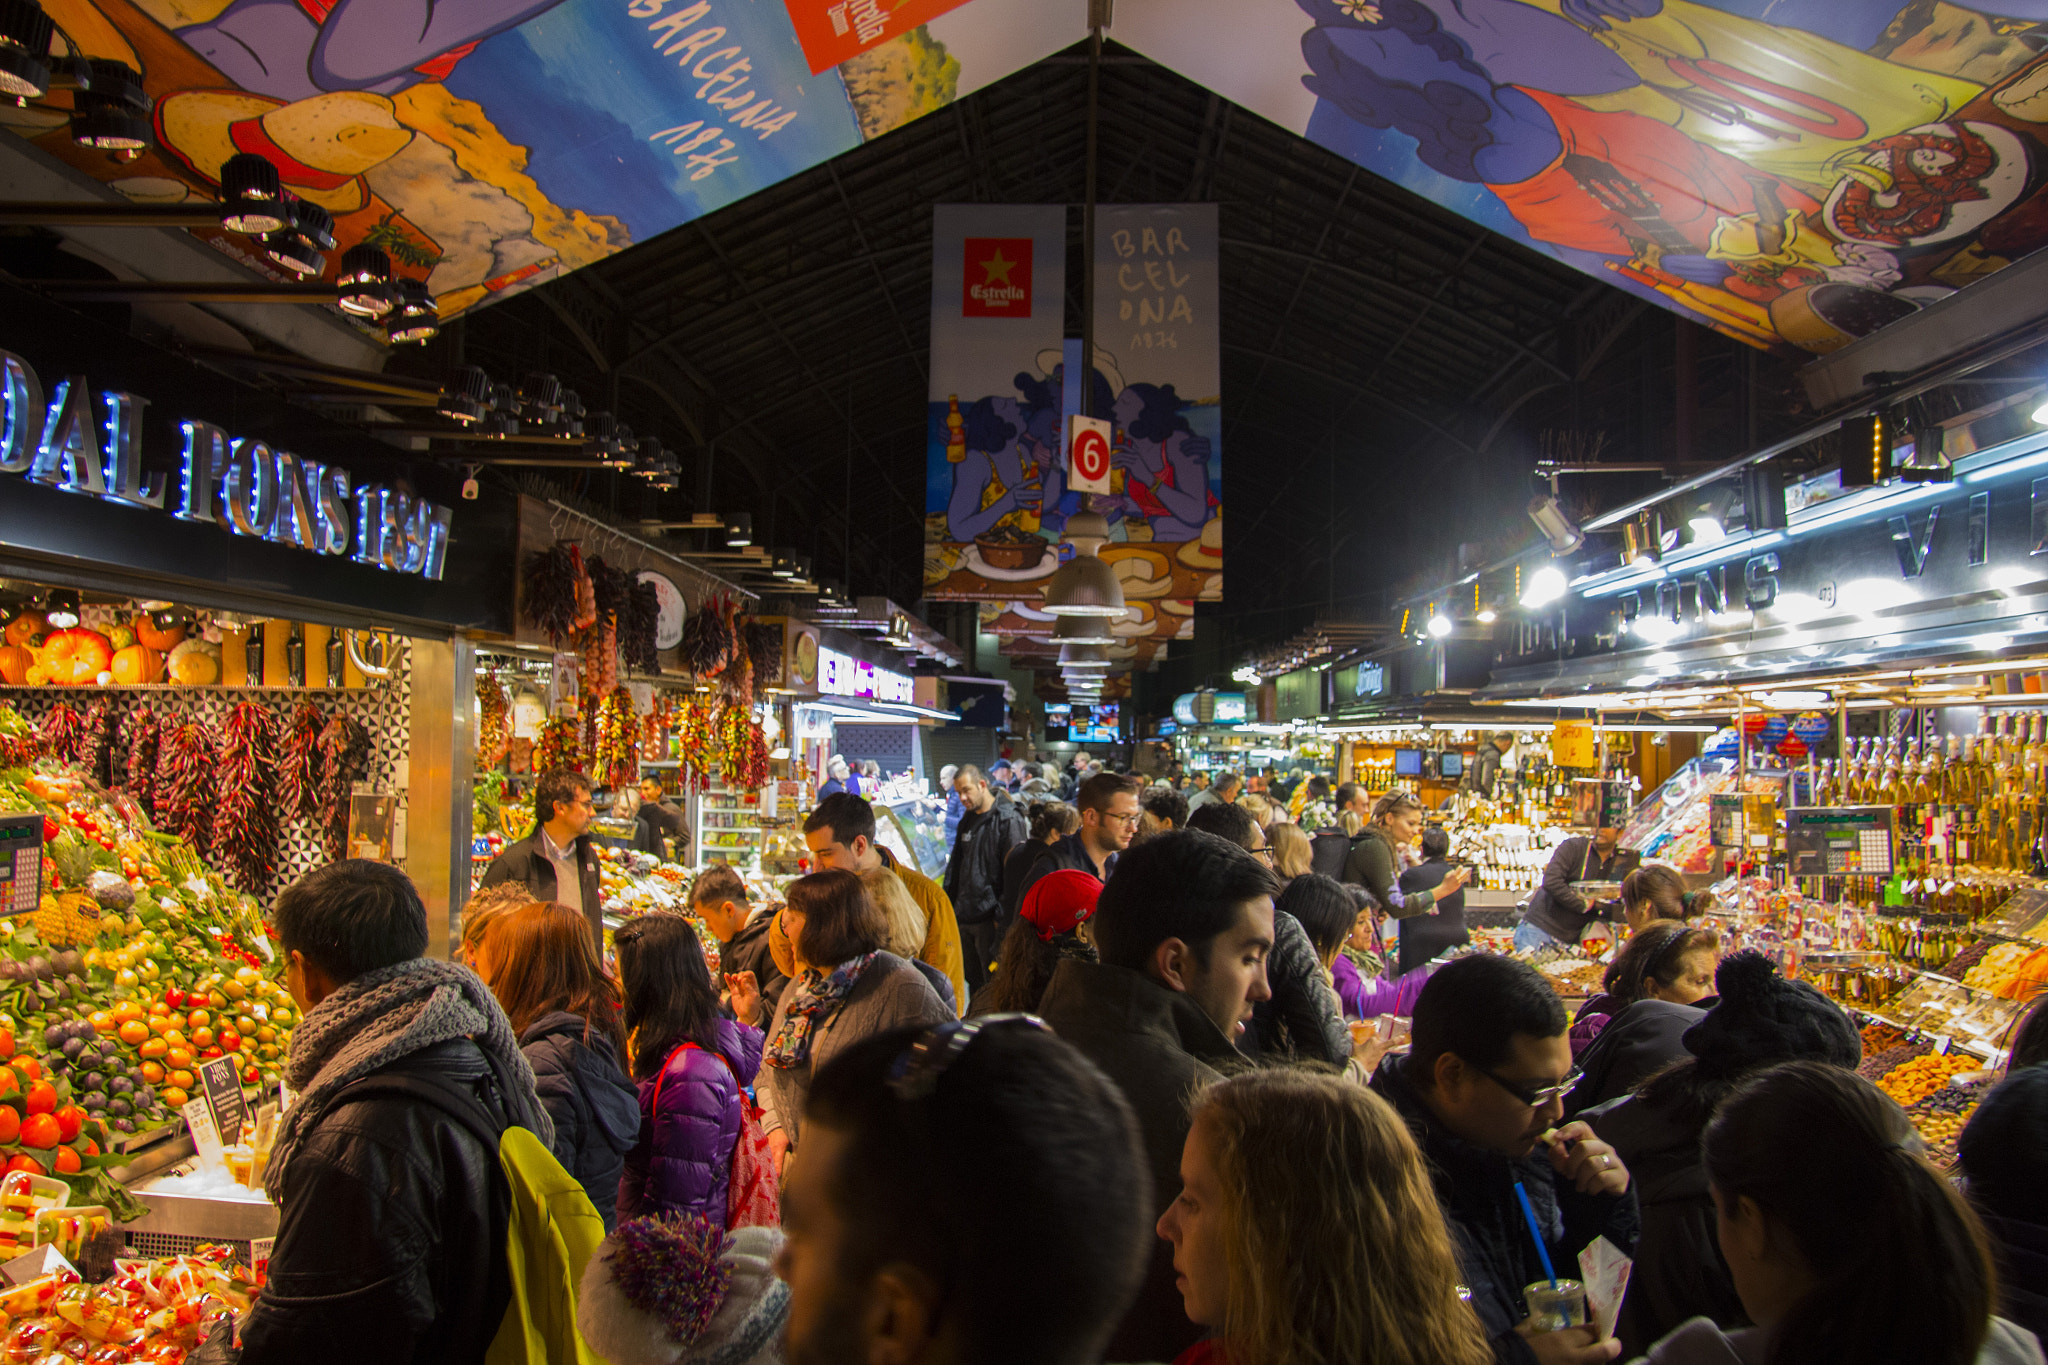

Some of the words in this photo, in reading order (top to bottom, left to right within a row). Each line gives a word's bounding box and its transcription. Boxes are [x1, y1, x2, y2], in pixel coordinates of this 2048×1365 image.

[827, 1, 849, 37] Damm
[649, 120, 739, 181] 1876
[1112, 227, 1189, 258] BAR
[970, 283, 1024, 300] Estrella
[1118, 260, 1191, 291] CEL
[1119, 294, 1192, 325] ONA
[1130, 330, 1178, 350] 1876
[1083, 438, 1100, 473] 6
[172, 420, 351, 556] PONS
[1617, 552, 1782, 635] PONS
